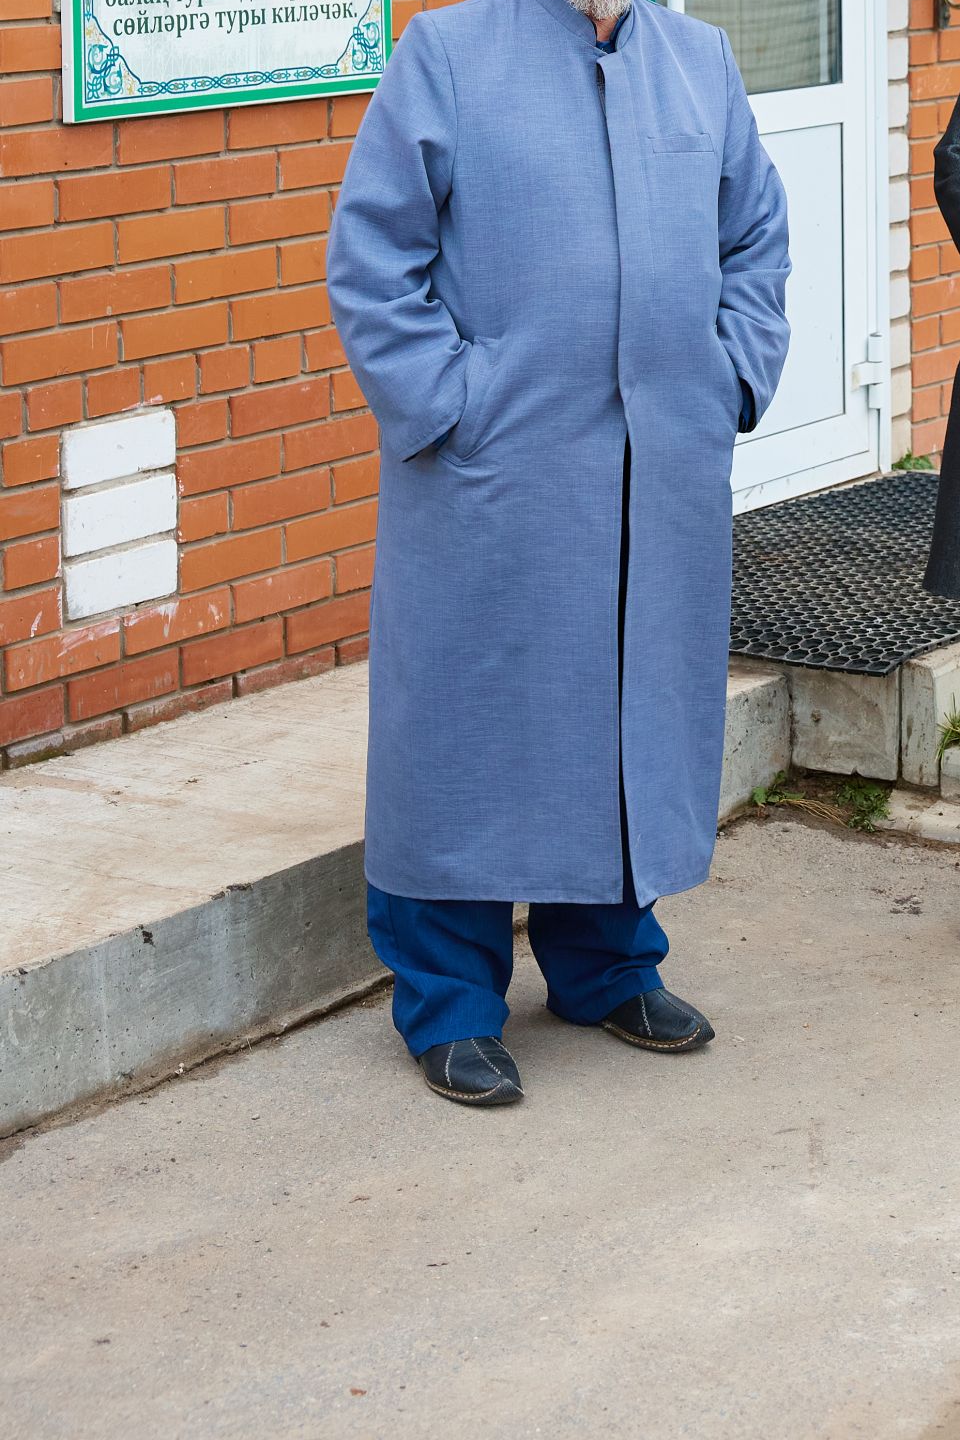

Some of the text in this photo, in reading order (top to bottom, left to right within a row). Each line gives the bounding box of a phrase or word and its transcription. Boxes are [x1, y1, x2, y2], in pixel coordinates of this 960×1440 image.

[113, 1, 358, 37] сөйләргә туры киләчәк.
